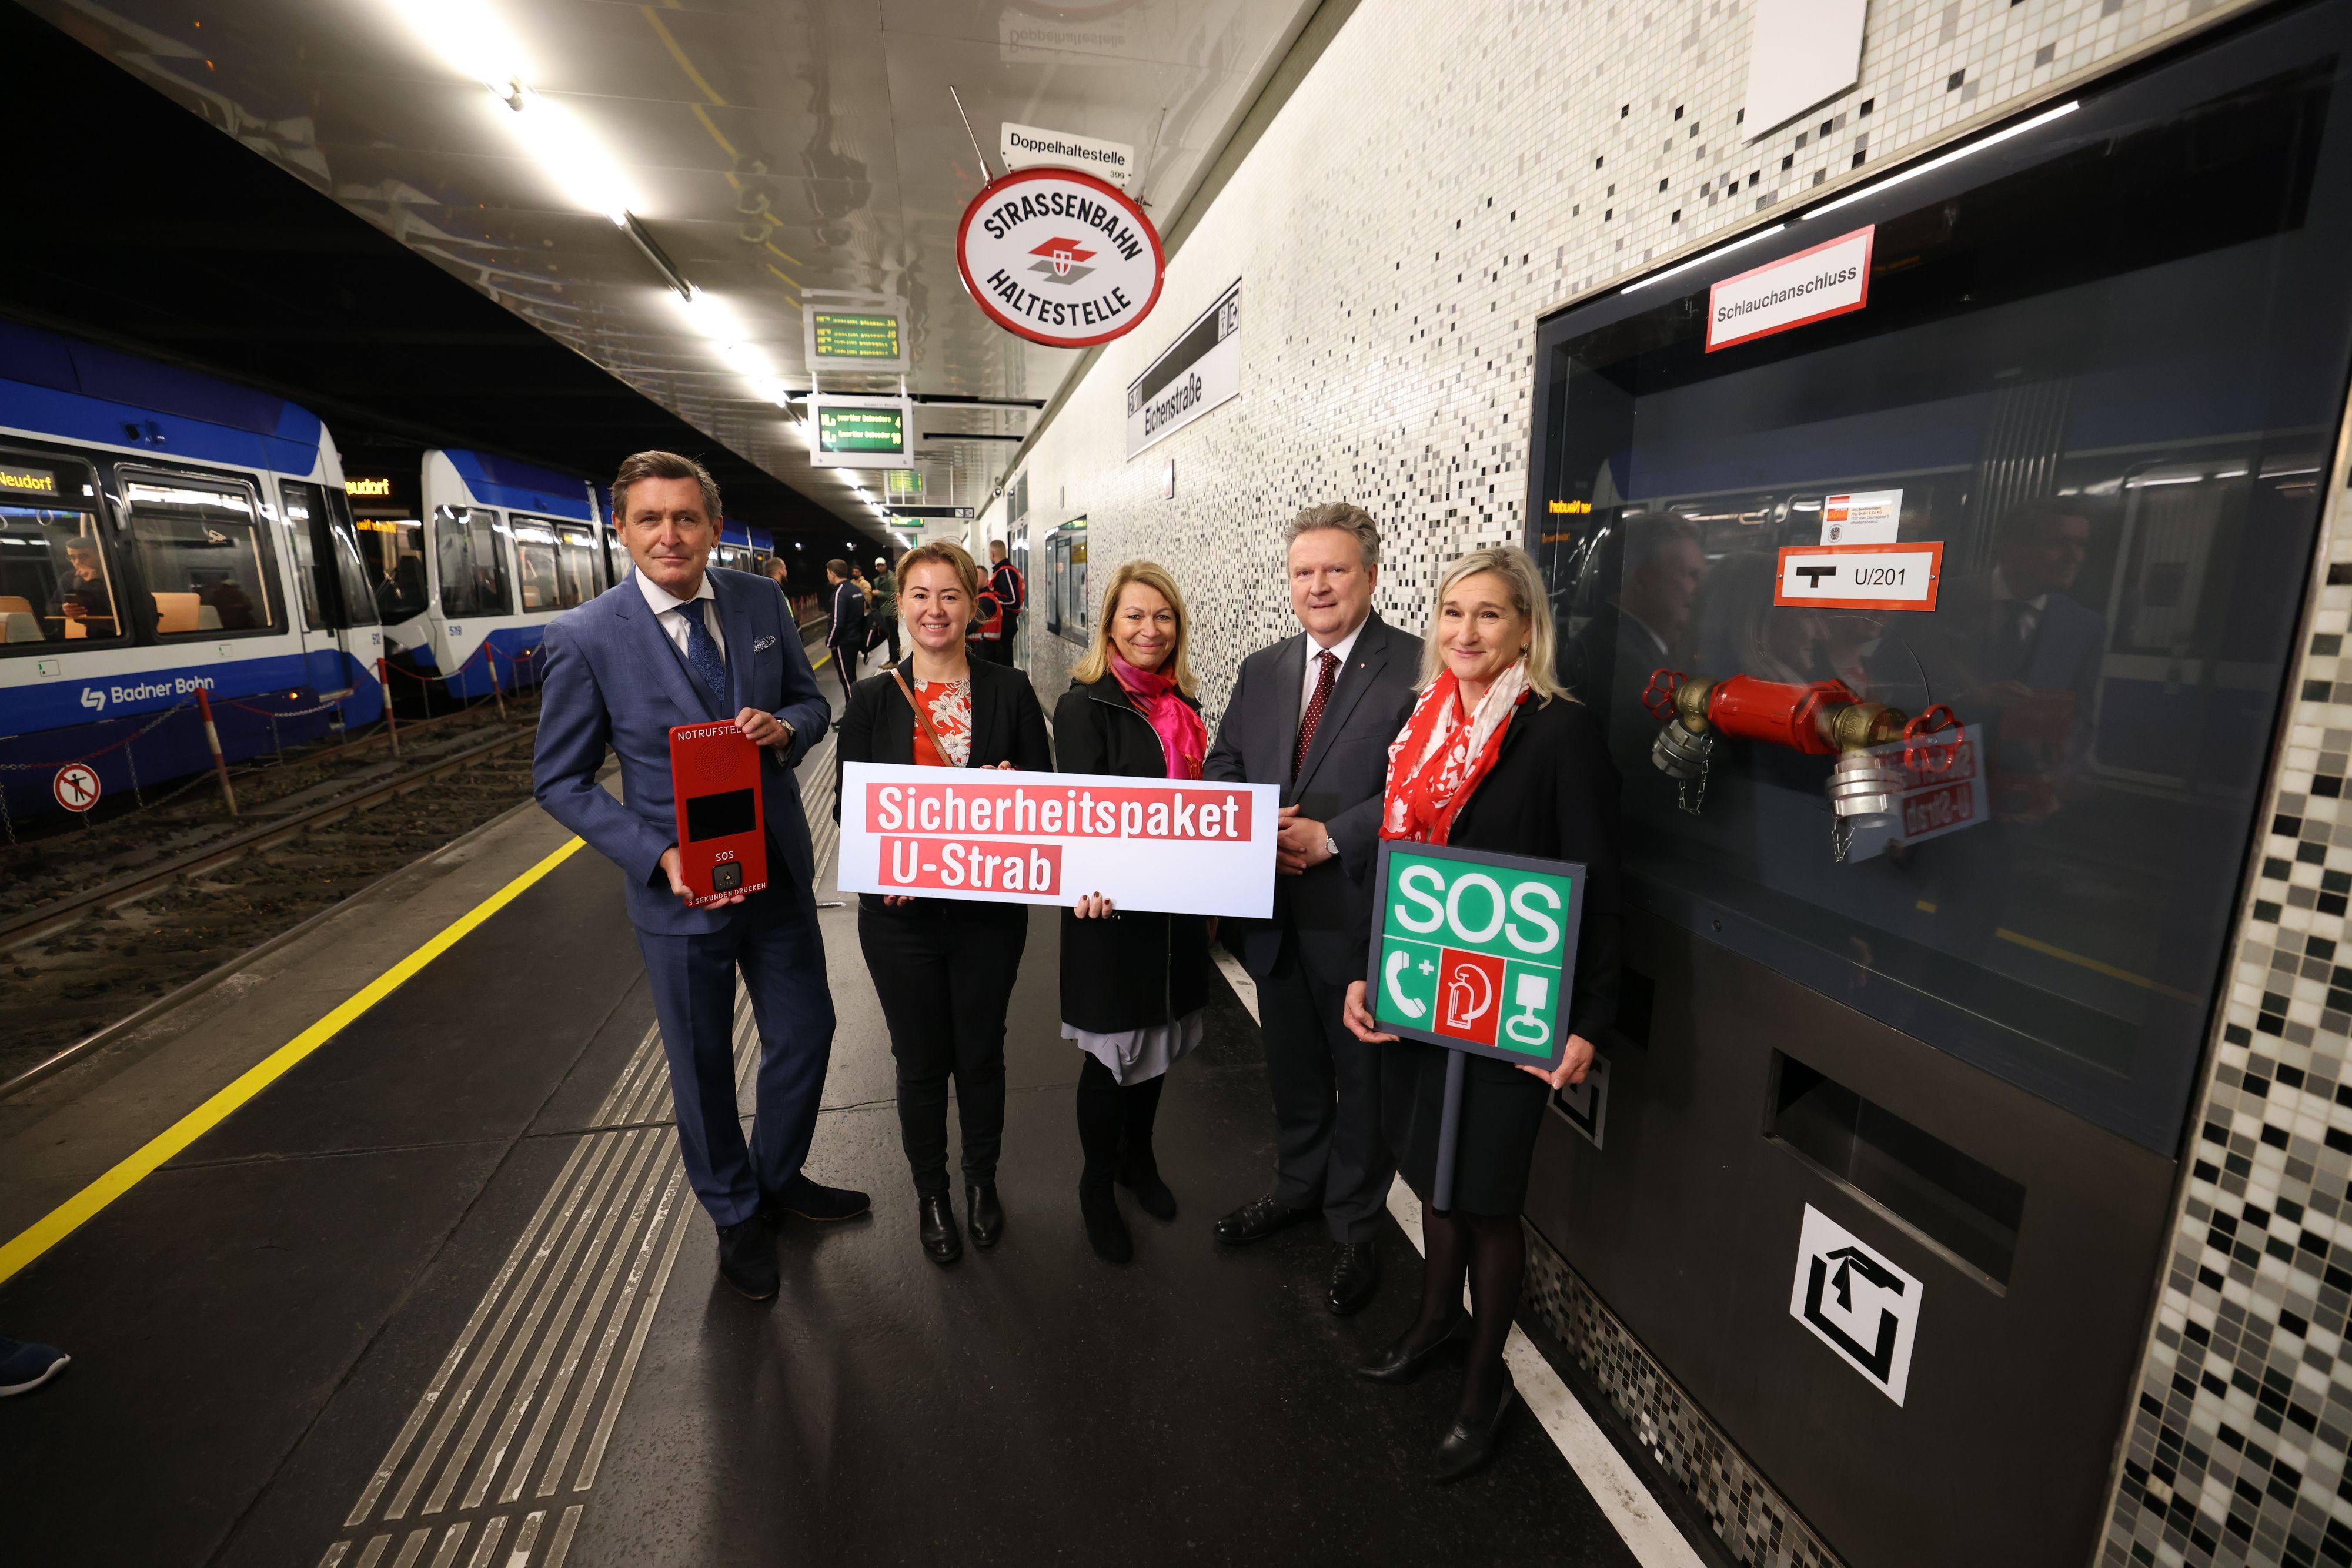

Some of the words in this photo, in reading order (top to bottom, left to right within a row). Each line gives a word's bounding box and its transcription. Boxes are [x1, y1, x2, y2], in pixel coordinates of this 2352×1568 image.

[1011, 132, 1125, 166] Doppelhaltestelle
[1110, 170, 1125, 179] 399
[984, 192, 1142, 261] STRASSENBAHN
[987, 269, 1131, 326] HALTESTELLE
[1718, 266, 1856, 322] Schlauchanschluss
[1145, 372, 1202, 436] Eichenstraße
[0, 472, 52, 490] Neudorf
[345, 478, 389, 495] eudorf
[1855, 568, 1906, 586] U/201
[111, 683, 172, 704] Badner
[175, 676, 215, 694] Bahn
[677, 725, 742, 741] NOTRUFSTEL
[878, 785, 1239, 847] Sicherheitspaket
[716, 850, 734, 862] SOS
[892, 840, 1051, 891] U-Strab
[695, 890, 733, 905] SEKUNDEN
[1394, 864, 1561, 954] SOS
